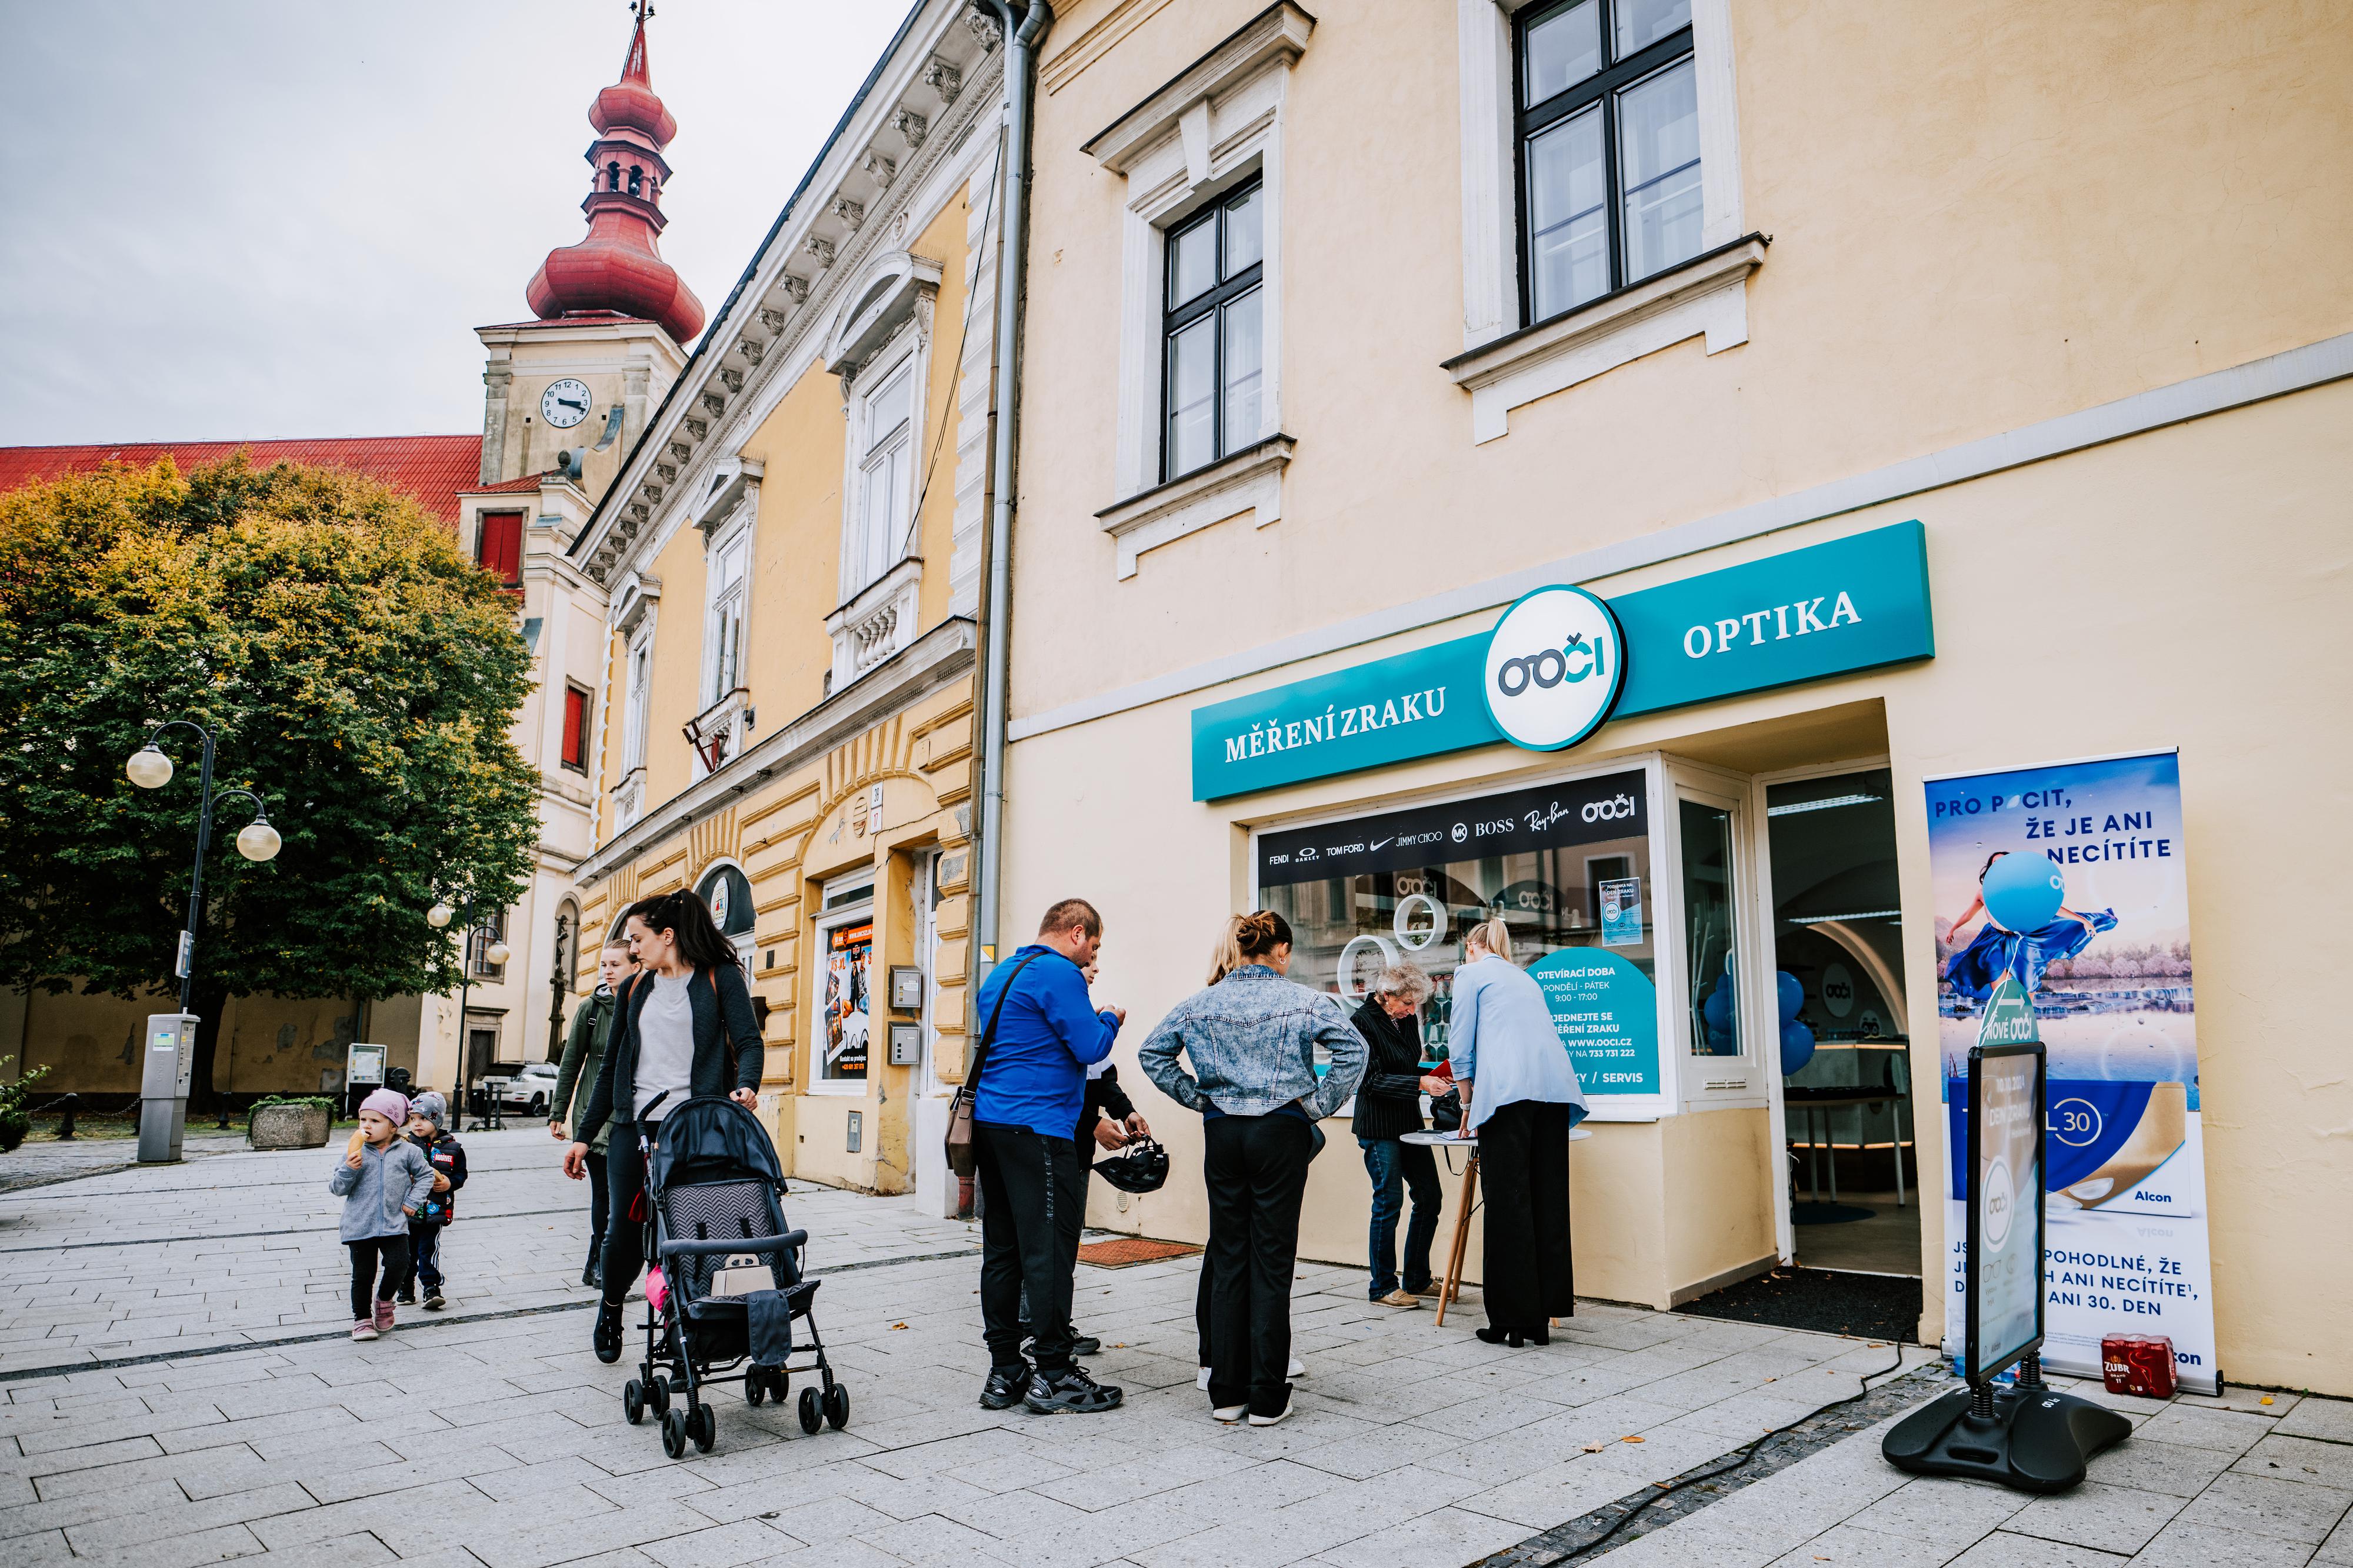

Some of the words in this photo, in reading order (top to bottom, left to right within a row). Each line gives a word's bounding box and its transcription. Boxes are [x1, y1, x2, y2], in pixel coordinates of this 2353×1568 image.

[1683, 590, 1862, 659] OPTIKA
[1225, 704, 1337, 763] MĚŘENÍ
[1340, 686, 1447, 735] ZRAKU
[1935, 797, 1981, 818] PRO
[874, 813, 878, 828] 17
[1475, 818, 1514, 837] BOSS
[2026, 817, 2055, 839] ŽE
[2065, 817, 2092, 836] JE
[2103, 811, 2152, 832] ANI
[1395, 833, 1417, 847] JIMMY
[1418, 831, 1442, 843] CHOO
[1326, 846, 1343, 856] TOM
[1343, 843, 1365, 854] FORD
[2047, 837, 2171, 865] NECÍTÍTE
[1269, 855, 1289, 865] FENDI
[1537, 967, 1585, 980] OTEVÍRACÍ
[1588, 967, 1615, 977] DOBA
[1543, 982, 1578, 992] PONDĚLÍ
[1585, 981, 1609, 990] PÁTEK
[1578, 993, 1597, 1001] 17:00
[1601, 1012, 1613, 1021] SE
[1555, 1023, 1585, 1033] ĚŘENÍ
[1587, 1024, 1619, 1033] ZRAKU
[1568, 1039, 1632, 1047] WWW.OOCI.CZ
[1602, 1072, 1644, 1083] SERVIS
[2064, 1112, 2090, 1132] 30
[435, 1154, 452, 1162] MARVEL
[2135, 1191, 2171, 1202] Alcon
[2045, 1249, 2152, 1274] POHODLNÉ,
[2159, 1257, 2181, 1275] ŽE
[2062, 1272, 2094, 1287] ANI
[2048, 1291, 2080, 1306] ANI
[2088, 1295, 2115, 1310] 30.
[2123, 1299, 2161, 1316] DEN
[2104, 1362, 2131, 1374] ZUBR
